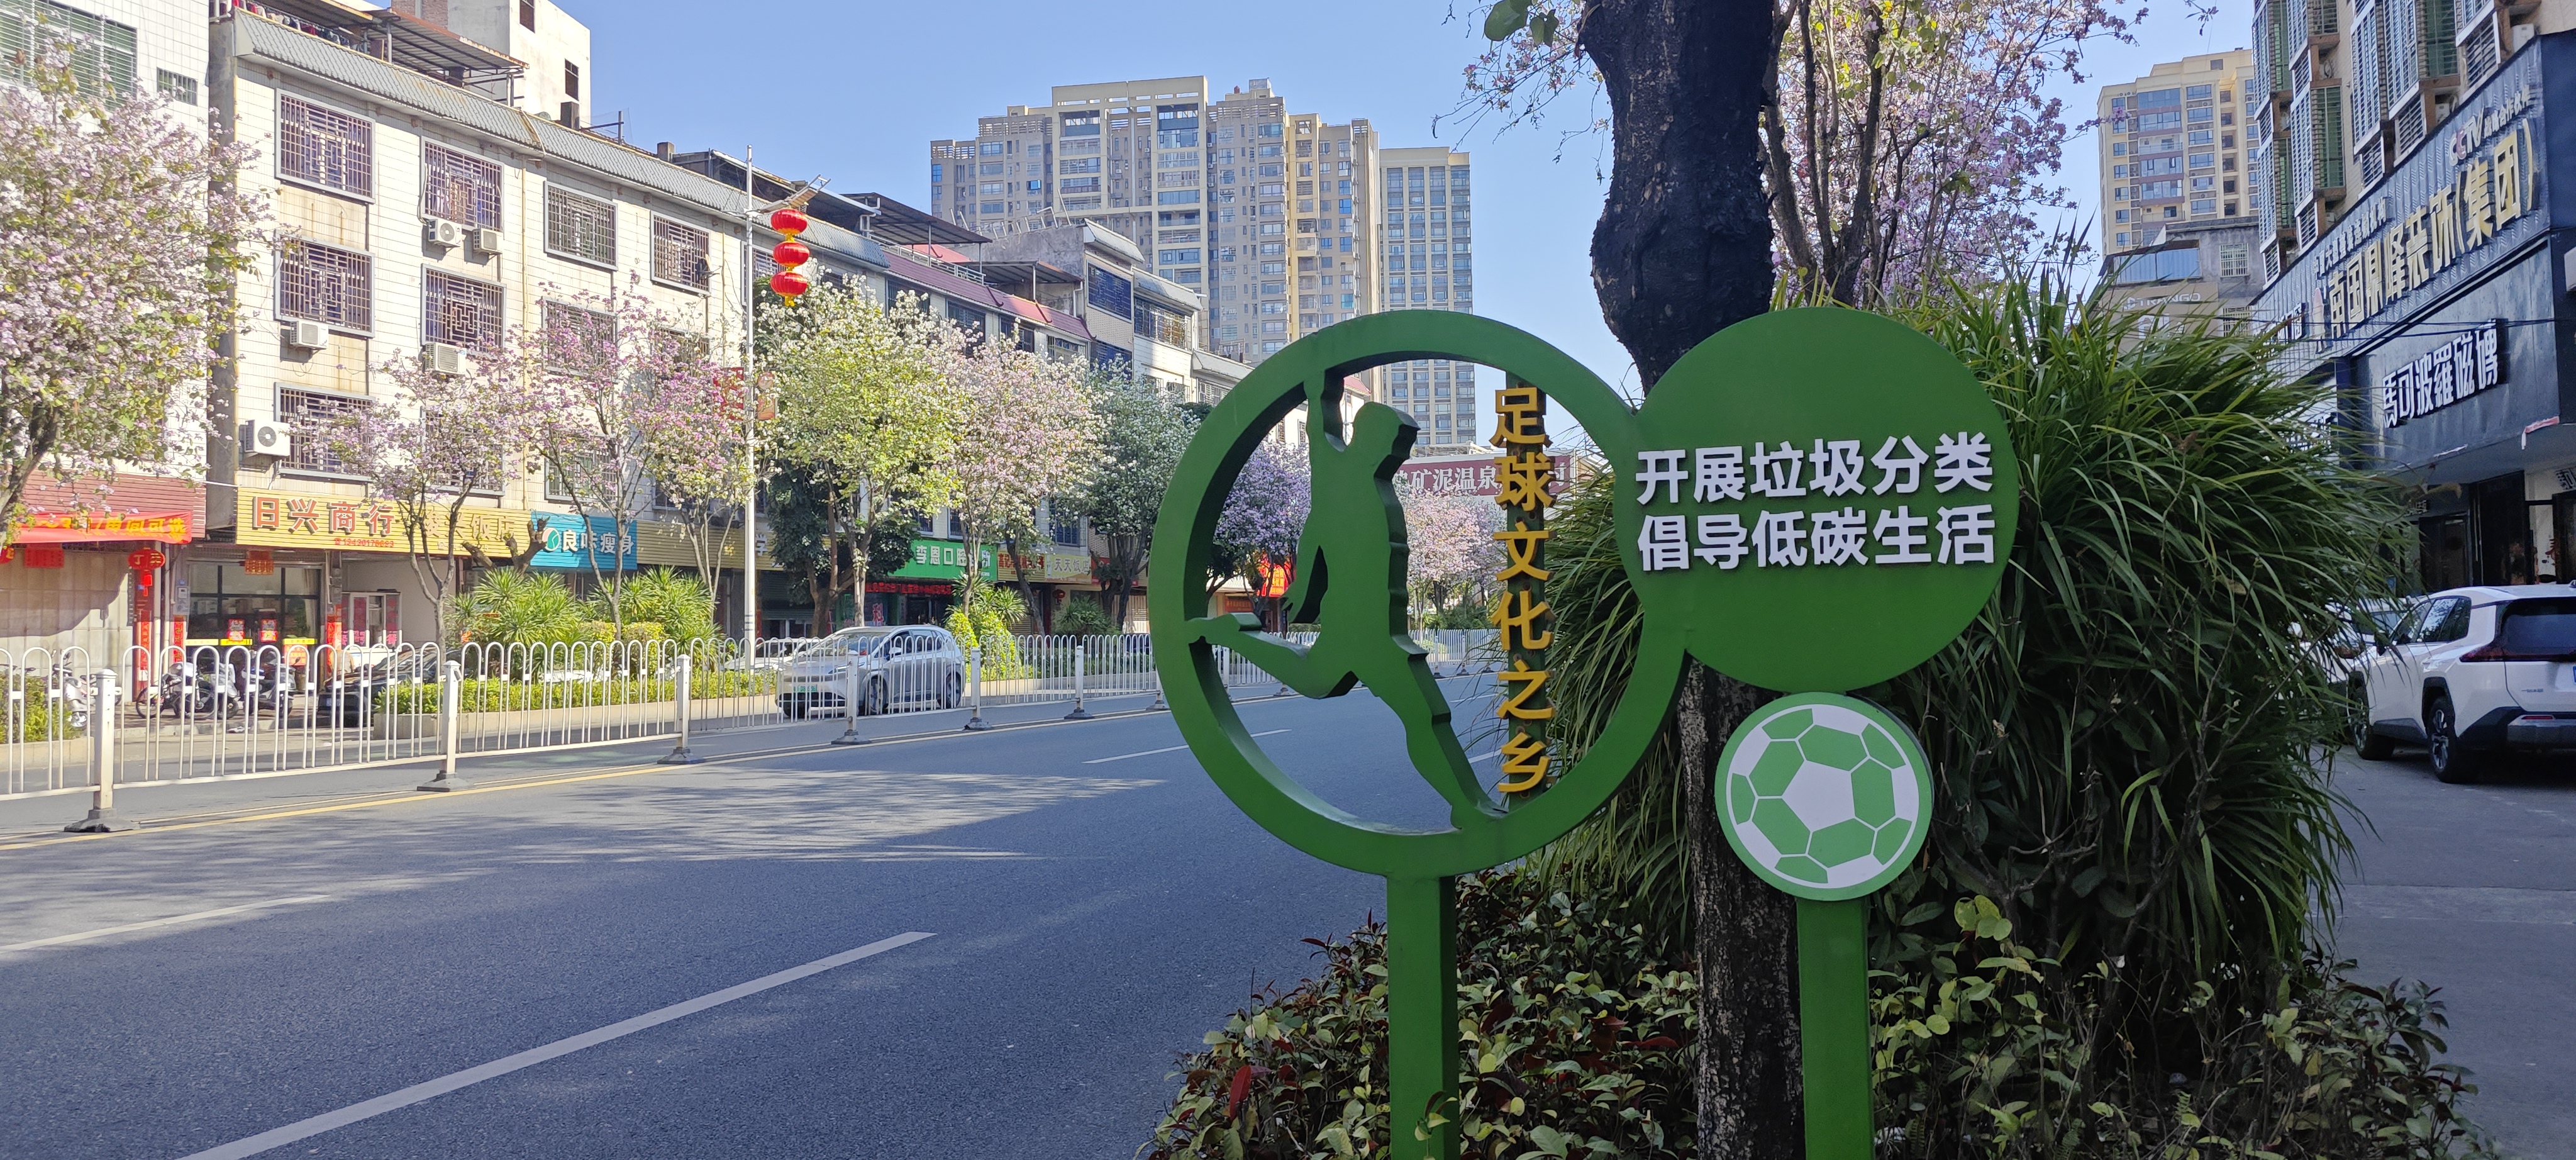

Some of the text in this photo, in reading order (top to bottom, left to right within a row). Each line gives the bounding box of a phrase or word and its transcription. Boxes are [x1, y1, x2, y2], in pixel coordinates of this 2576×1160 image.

[2382, 319, 2499, 428] 馬可波羅磁磚
[1636, 432, 1994, 505] 开展垃圾分类
[252, 496, 395, 537] 日兴商行
[1638, 505, 1996, 571] 倡导低碳生活
[916, 545, 991, 567] 李恩口腔所
[1054, 558, 1091, 574] 天天饭店
[1489, 387, 1557, 794] 足球文化之乡
